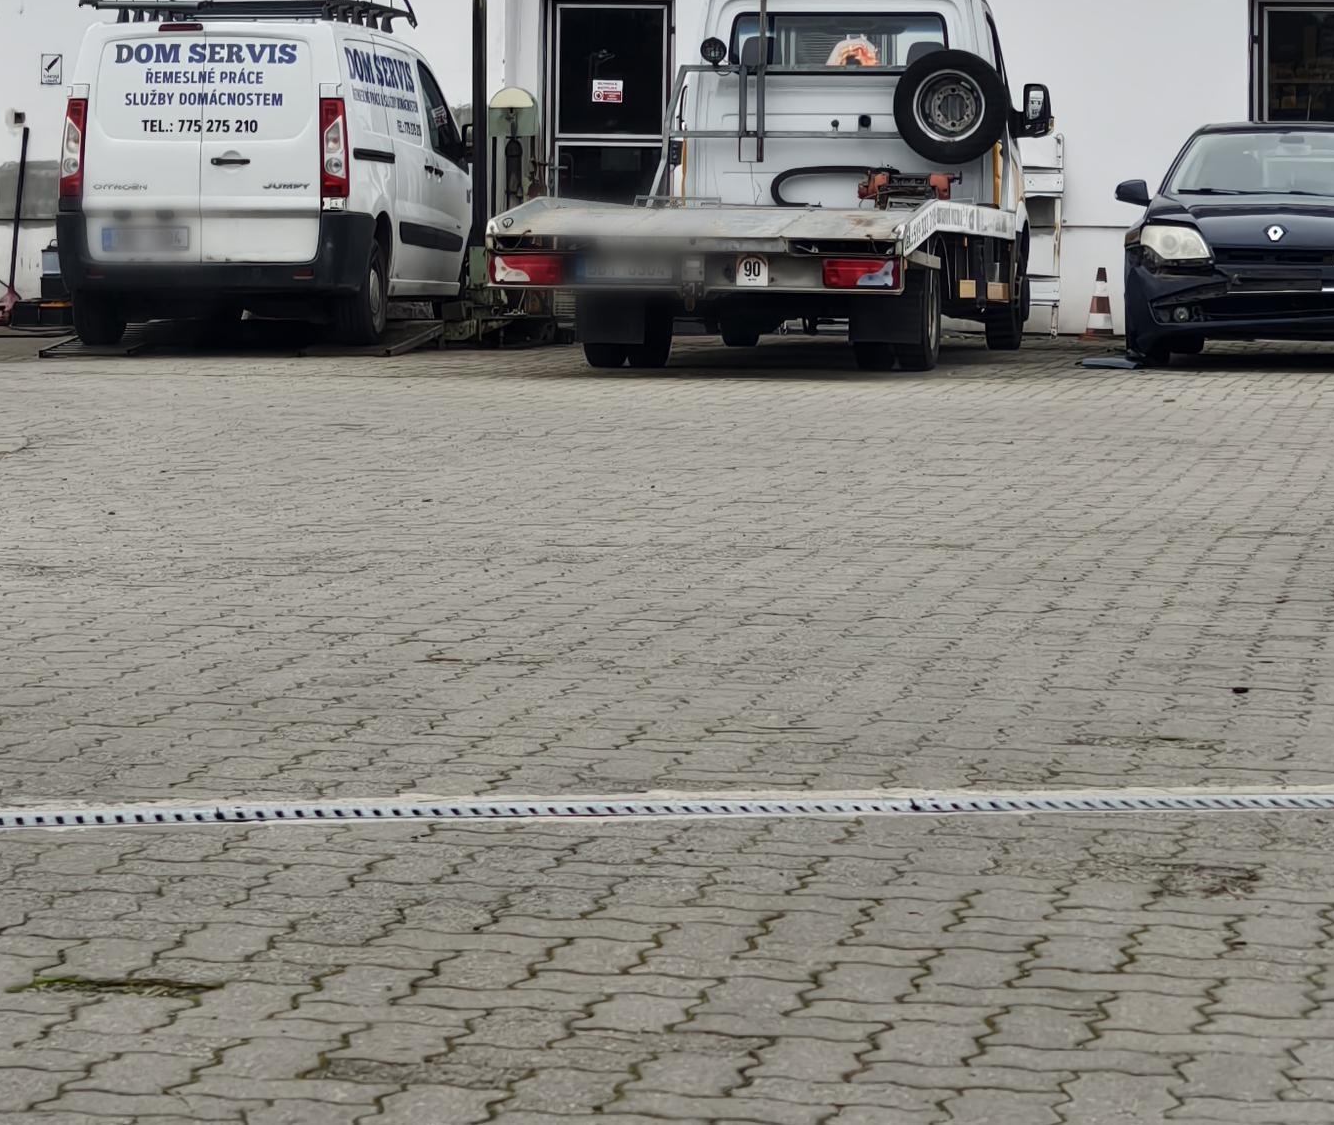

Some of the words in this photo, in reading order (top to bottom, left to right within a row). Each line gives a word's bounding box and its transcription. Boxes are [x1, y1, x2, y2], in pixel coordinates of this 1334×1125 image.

[115, 43, 181, 64] DOM
[188, 43, 298, 64] SERVIS
[145, 68, 216, 84] ŘEMESLNÉ
[220, 68, 264, 84] PRÁCE
[344, 47, 375, 84] DOM
[372, 54, 415, 93] SERVIS
[125, 89, 174, 106] SLUŽBY
[179, 89, 283, 106] DOMÁCNOSTEM
[142, 120, 173, 132] TEL.:
[178, 119, 202, 132] 775
[206, 119, 230, 132] 275
[234, 119, 258, 133] 210
[744, 260, 761, 277] 90
